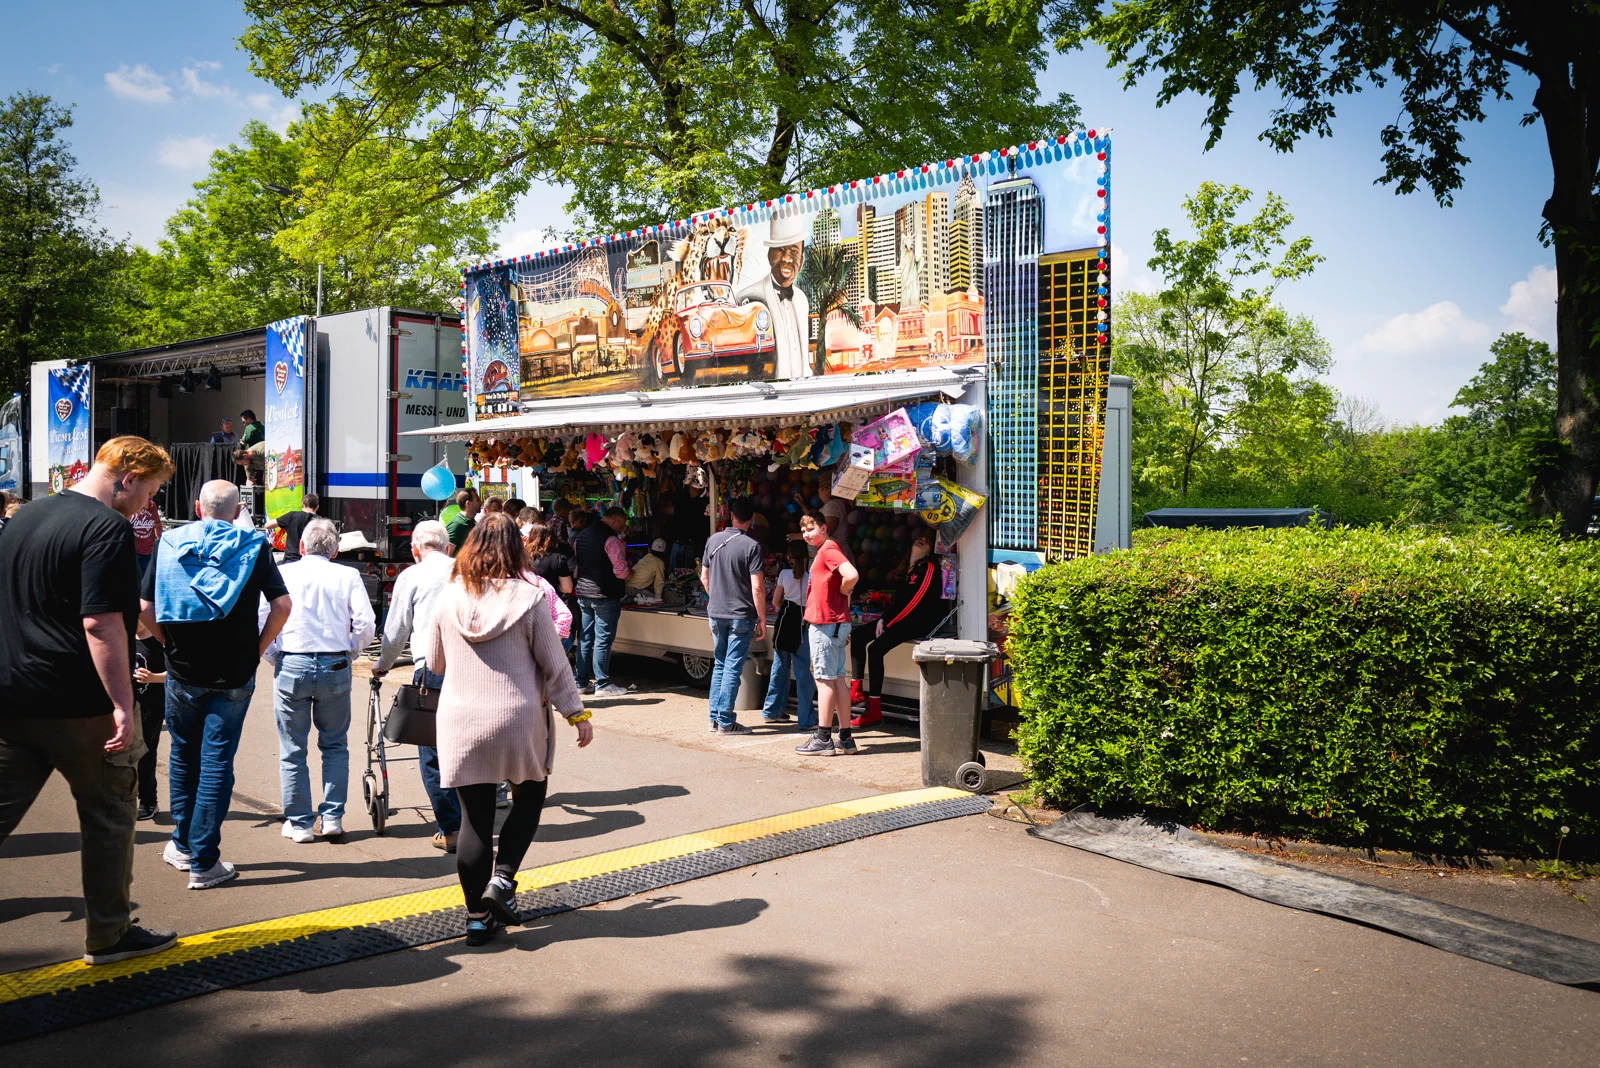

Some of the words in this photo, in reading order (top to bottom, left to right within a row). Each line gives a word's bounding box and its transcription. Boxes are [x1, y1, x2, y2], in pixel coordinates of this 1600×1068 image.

[446, 407, 466, 418] UND
[129, 513, 155, 531] Vintage
[926, 511, 940, 522] 09
